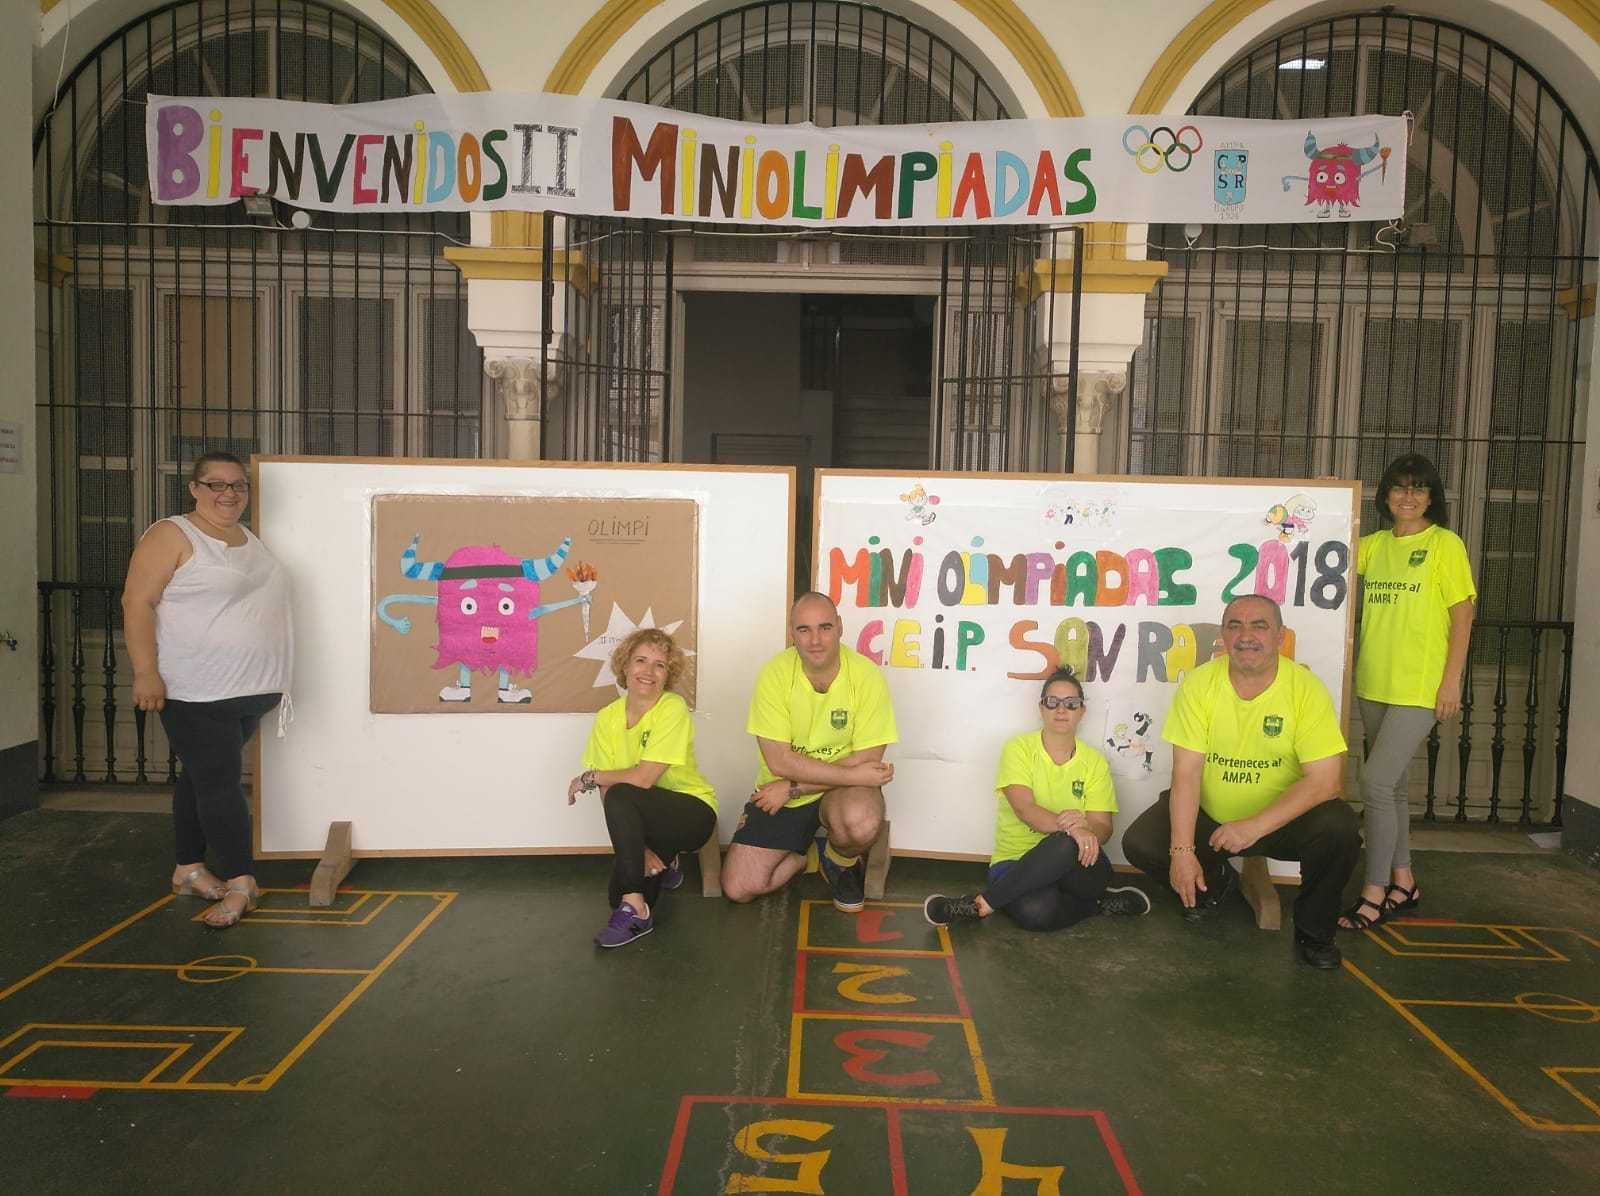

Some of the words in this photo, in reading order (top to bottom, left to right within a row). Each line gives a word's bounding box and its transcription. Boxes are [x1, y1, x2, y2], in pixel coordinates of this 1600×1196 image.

[1221, 539, 1349, 610] 2018
[1409, 582, 1422, 593] al
[1367, 592, 1391, 605] AMPA
[1007, 617, 1126, 682] SAN
[1222, 770, 1253, 784] AMPA
[1271, 757, 1283, 768] al
[832, 961, 917, 1004] 2
[833, 1029, 940, 1086] 3
[724, 1119, 834, 1196] 5
[965, 1126, 1065, 1196] 4
